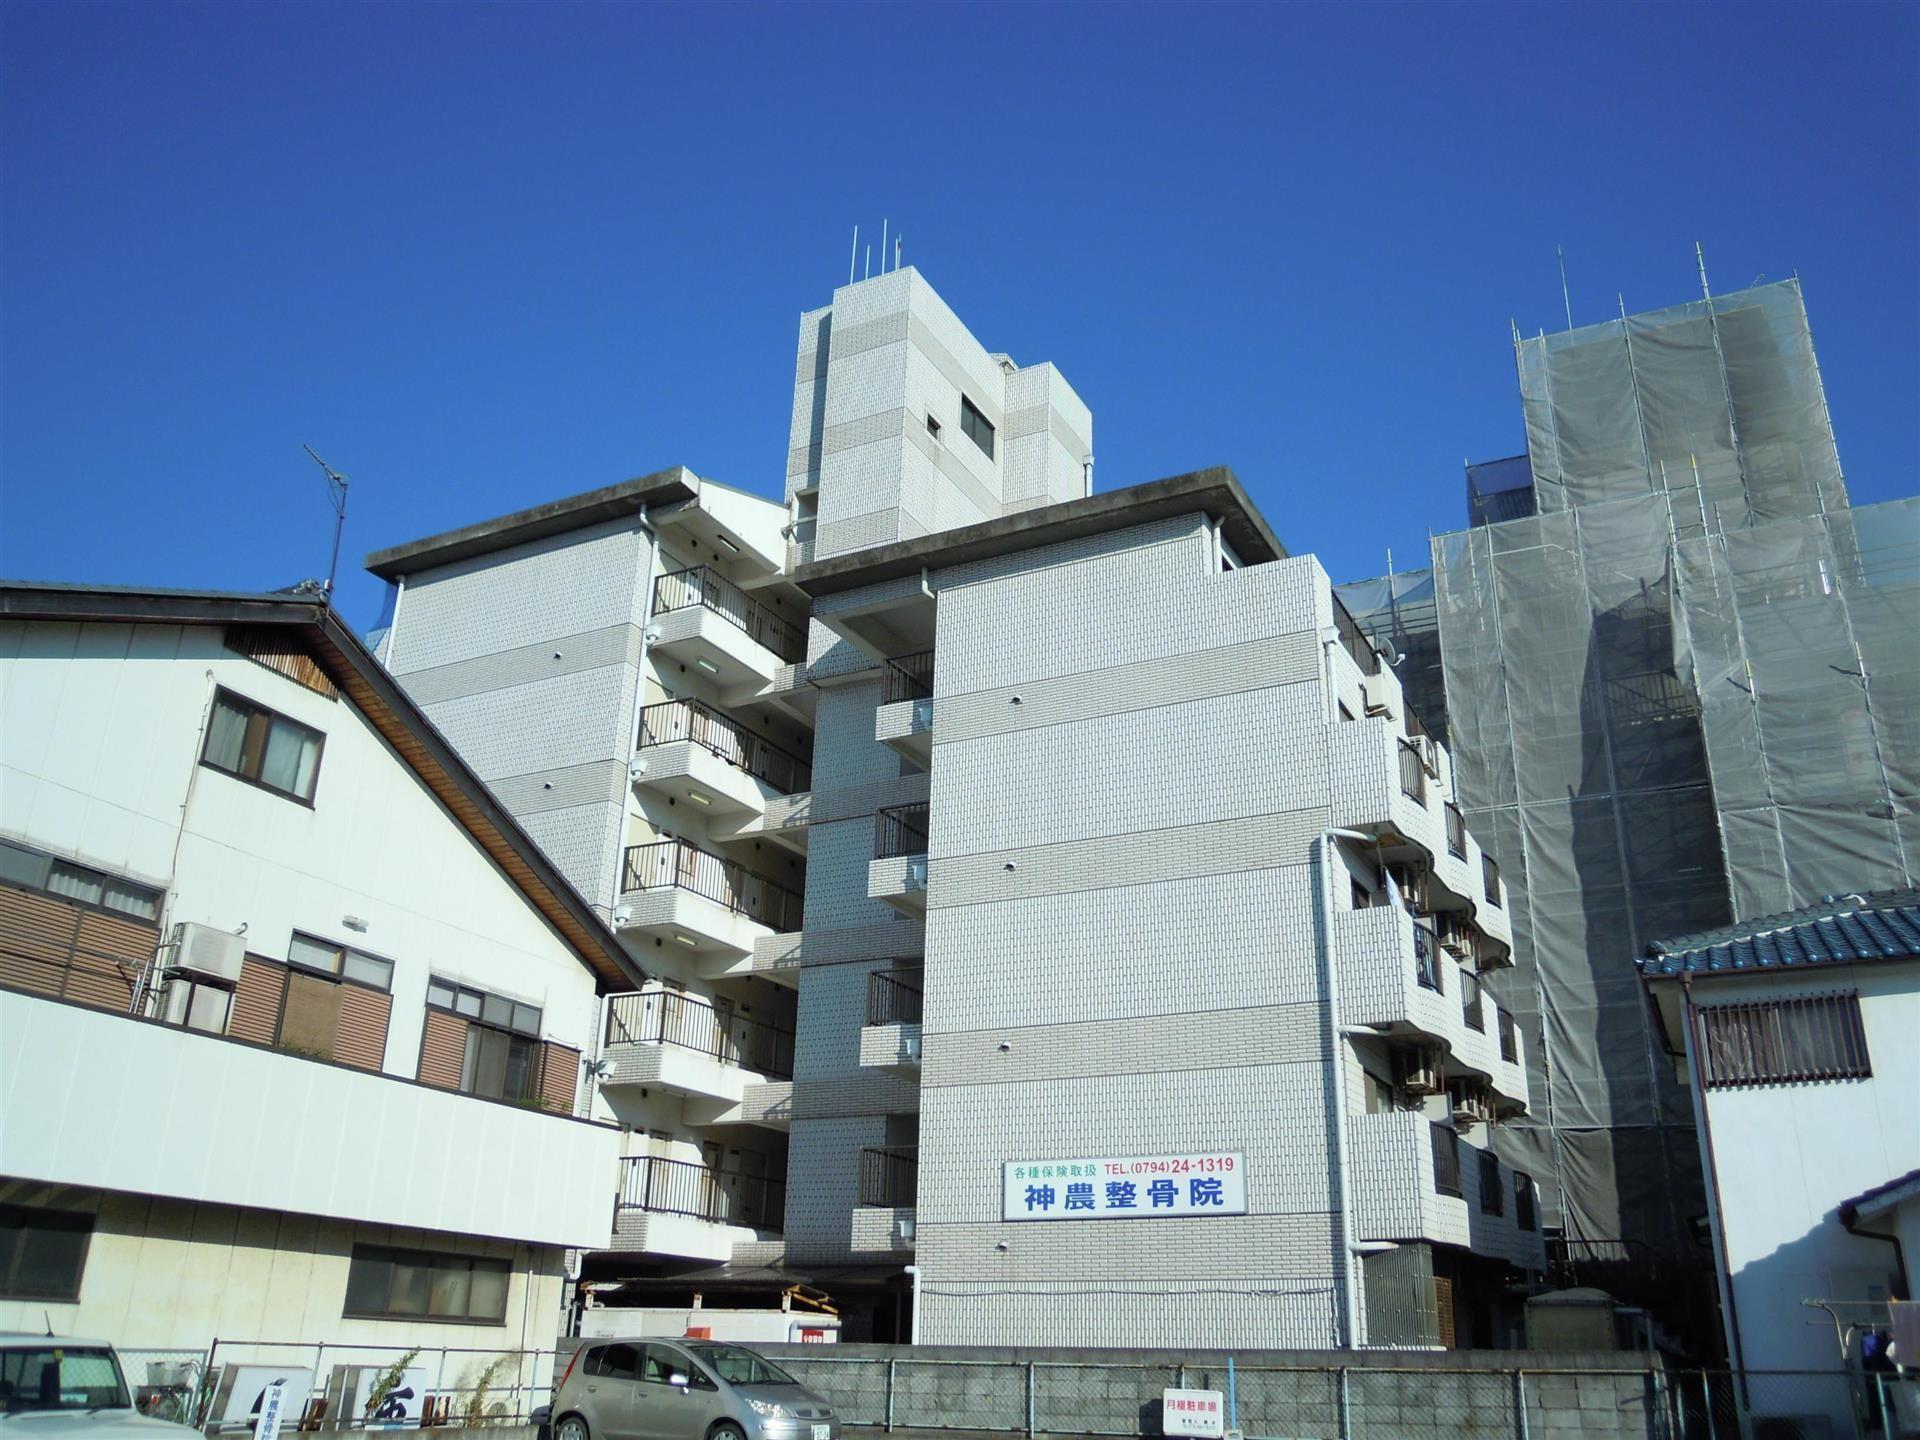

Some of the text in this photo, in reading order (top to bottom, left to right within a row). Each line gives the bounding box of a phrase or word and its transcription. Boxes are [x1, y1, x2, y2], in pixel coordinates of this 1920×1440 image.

[1014, 1163, 1097, 1180] 各種保険取扱
[1024, 1178, 1224, 1211] 神農整骨院
